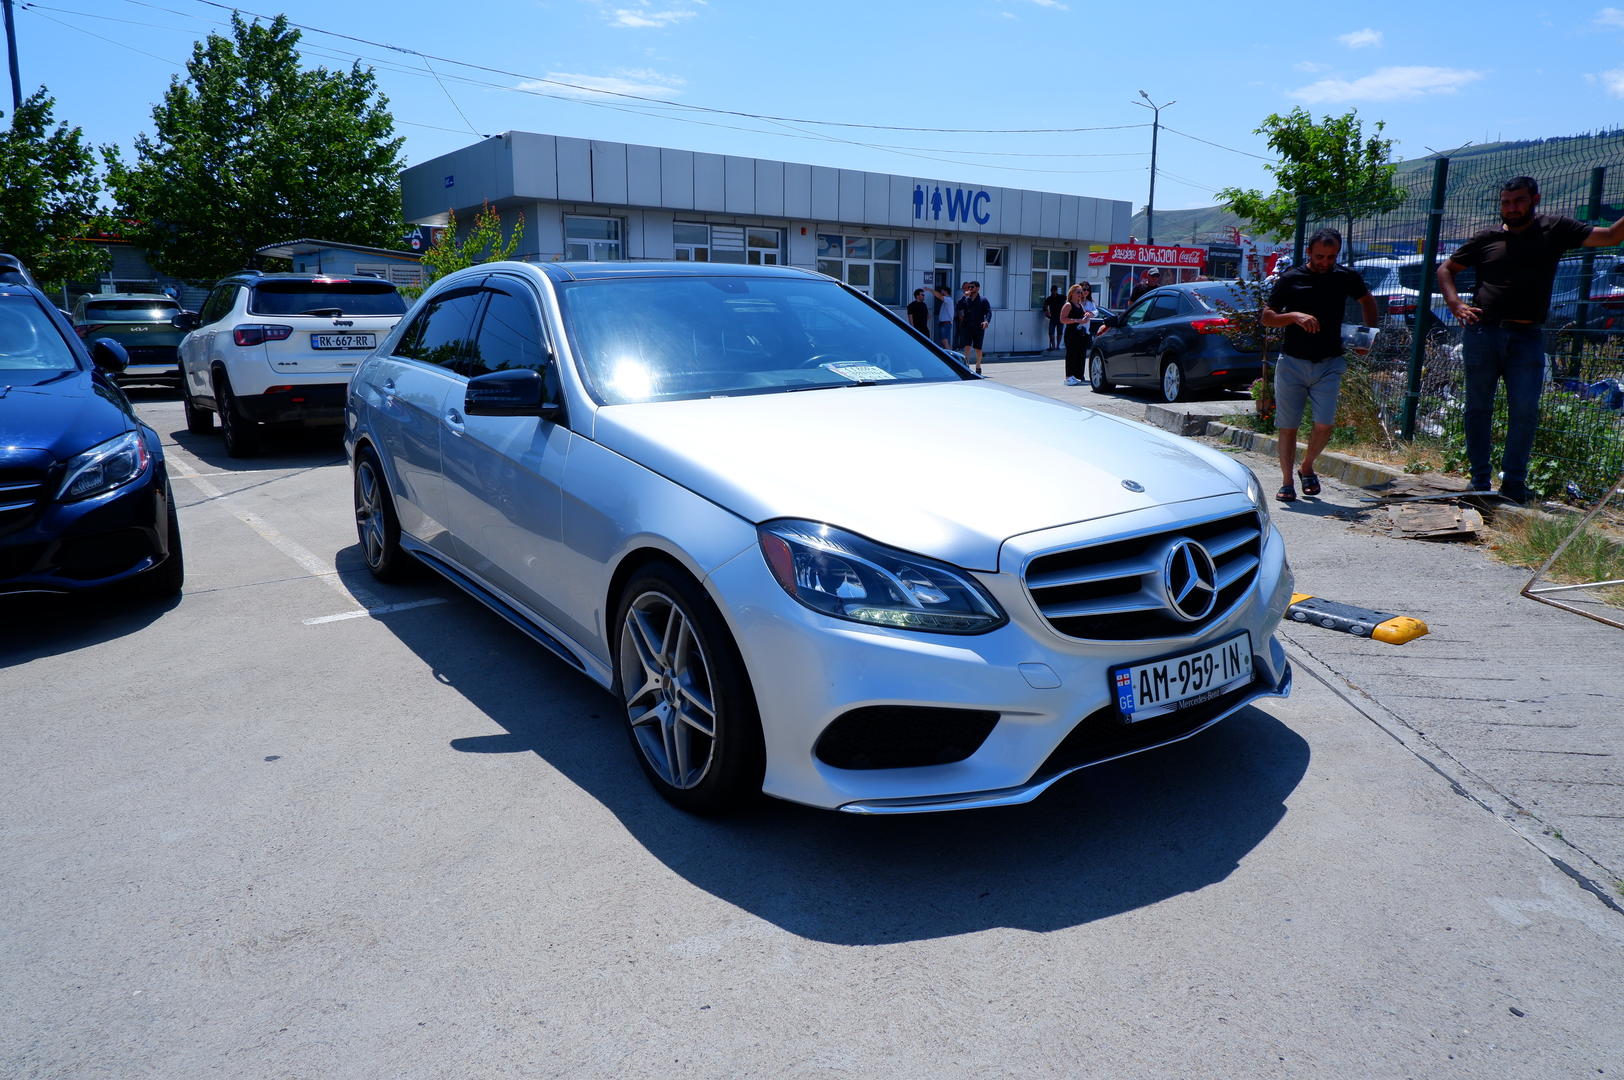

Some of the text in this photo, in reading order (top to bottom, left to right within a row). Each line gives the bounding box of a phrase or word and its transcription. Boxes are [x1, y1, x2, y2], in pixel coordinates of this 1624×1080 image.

[945, 187, 991, 225] WC
[1138, 247, 1177, 263] მარკეტი
[924, 273, 933, 281] WC
[319, 336, 368, 347] RK-667-RR
[1139, 642, 1241, 706] AM-959-IN
[1119, 694, 1134, 710] GE
[1178, 689, 1220, 711] Mercedes-Benz
